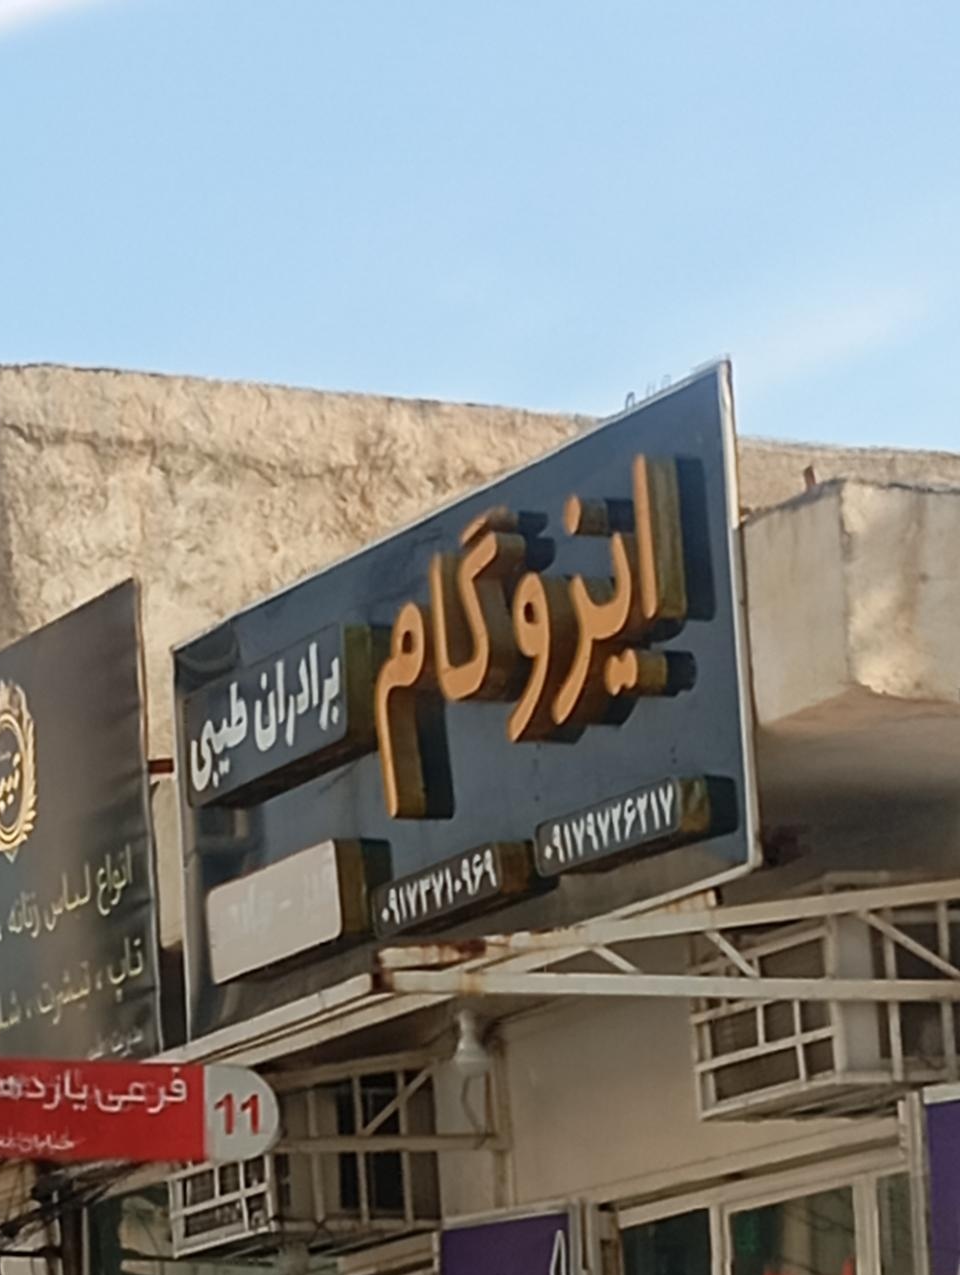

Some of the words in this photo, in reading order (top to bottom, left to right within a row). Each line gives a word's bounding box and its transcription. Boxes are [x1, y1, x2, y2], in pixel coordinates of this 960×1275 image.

[376, 454, 660, 819] ایزوگام
[255, 641, 341, 752] برادران
[190, 681, 248, 792] طیبی
[43, 863, 91, 931] لباس
[96, 843, 132, 916] انواع
[93, 1066, 188, 1114] فرعی
[214, 1092, 260, 1135] 11
